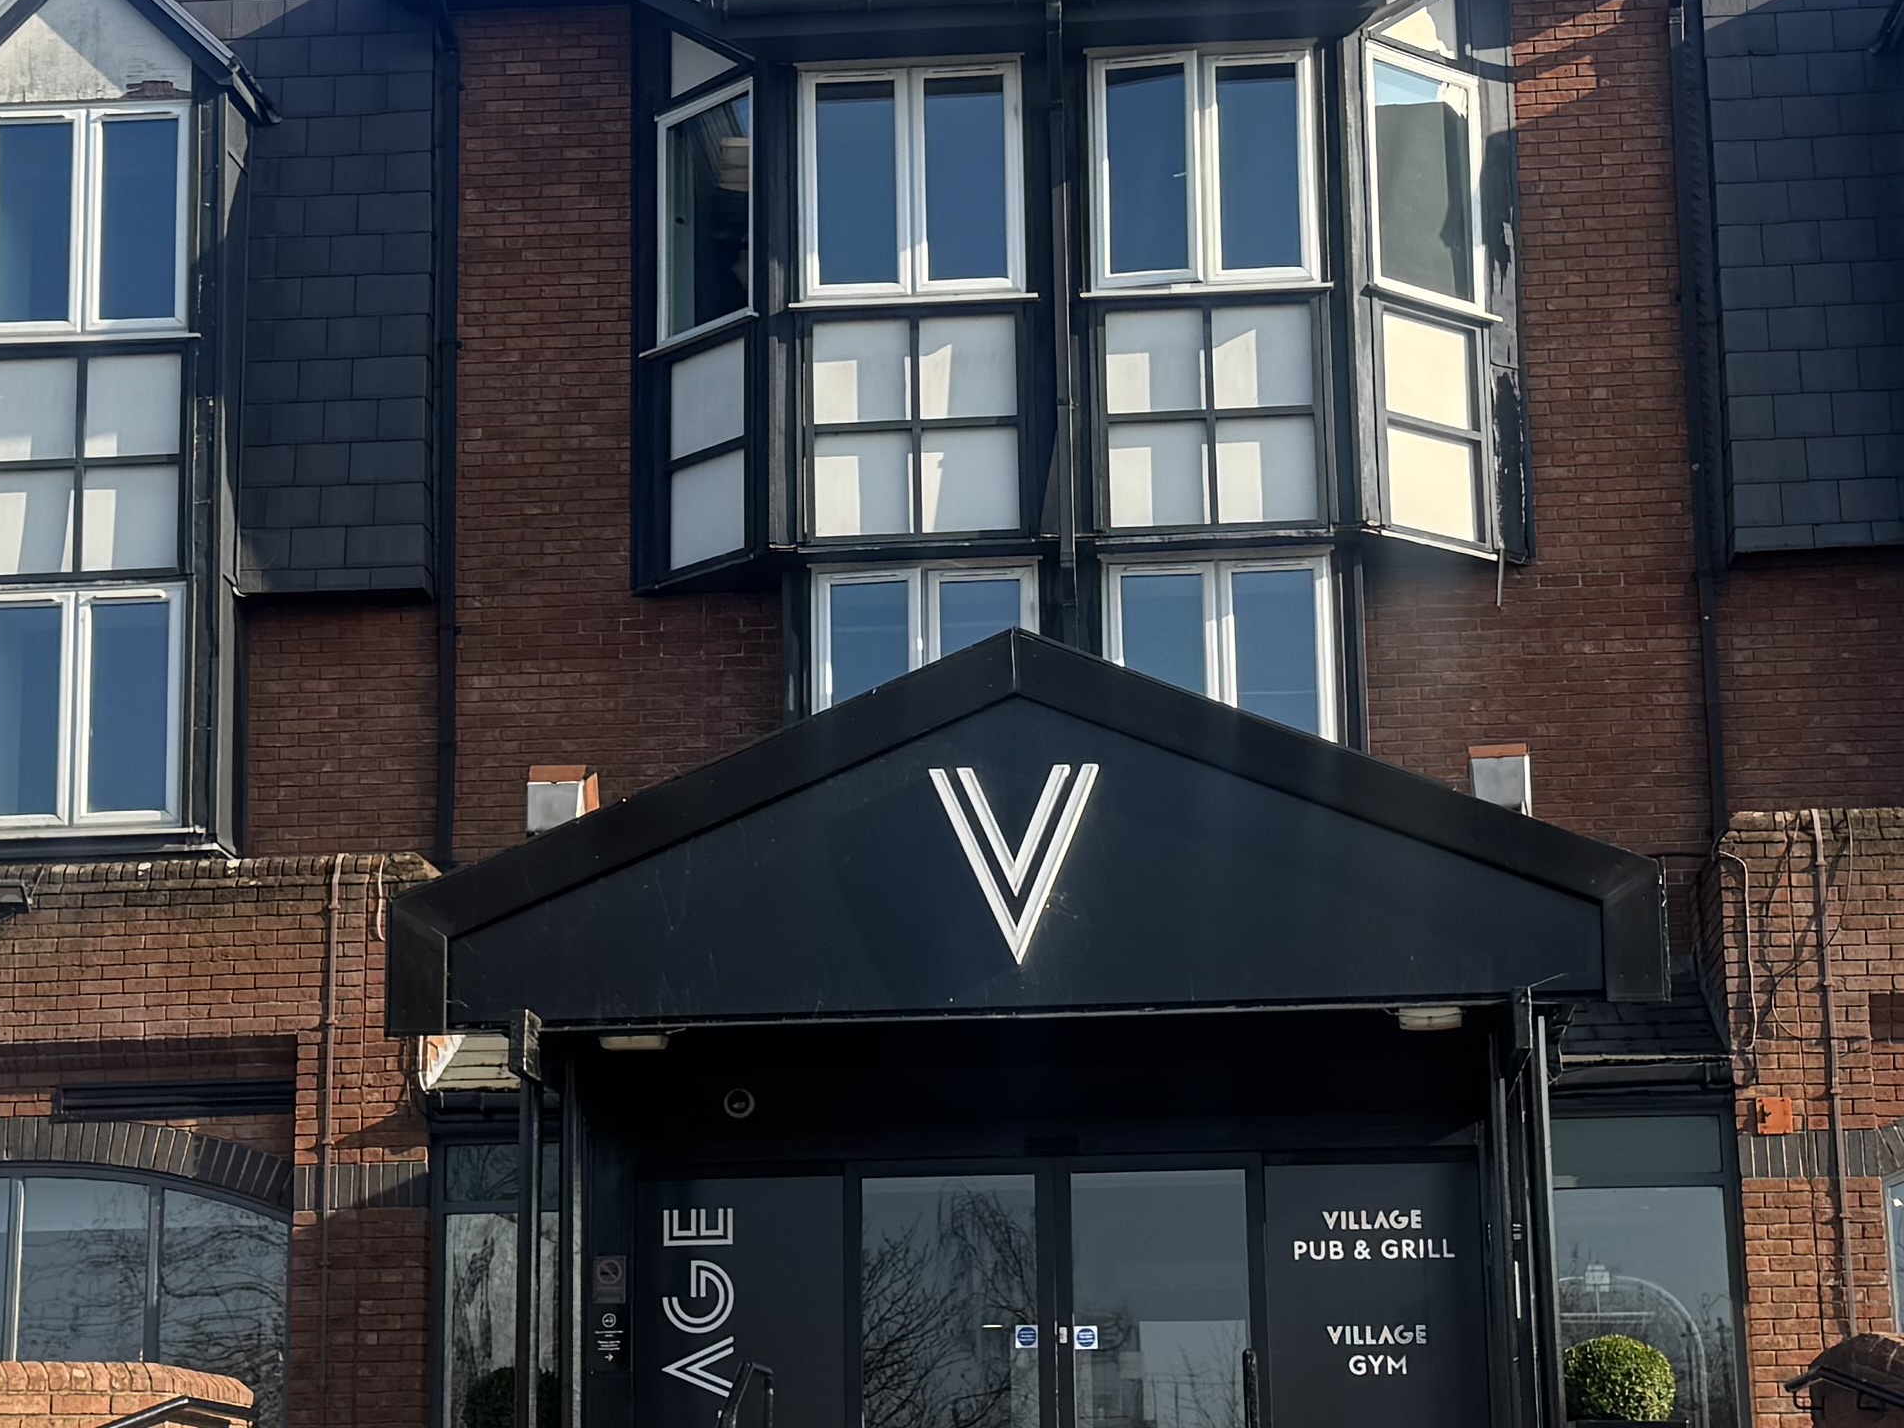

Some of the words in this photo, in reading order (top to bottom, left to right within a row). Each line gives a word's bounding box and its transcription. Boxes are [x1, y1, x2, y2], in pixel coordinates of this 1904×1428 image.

[928, 763, 1099, 965] V
[1322, 1209, 1423, 1230] VILLAGE
[1293, 1240, 1345, 1260] PUB
[1353, 1239, 1371, 1260] &
[1381, 1238, 1455, 1259] GRILL
[1326, 1324, 1427, 1345] VILLAGE
[1348, 1354, 1407, 1375] GYM
